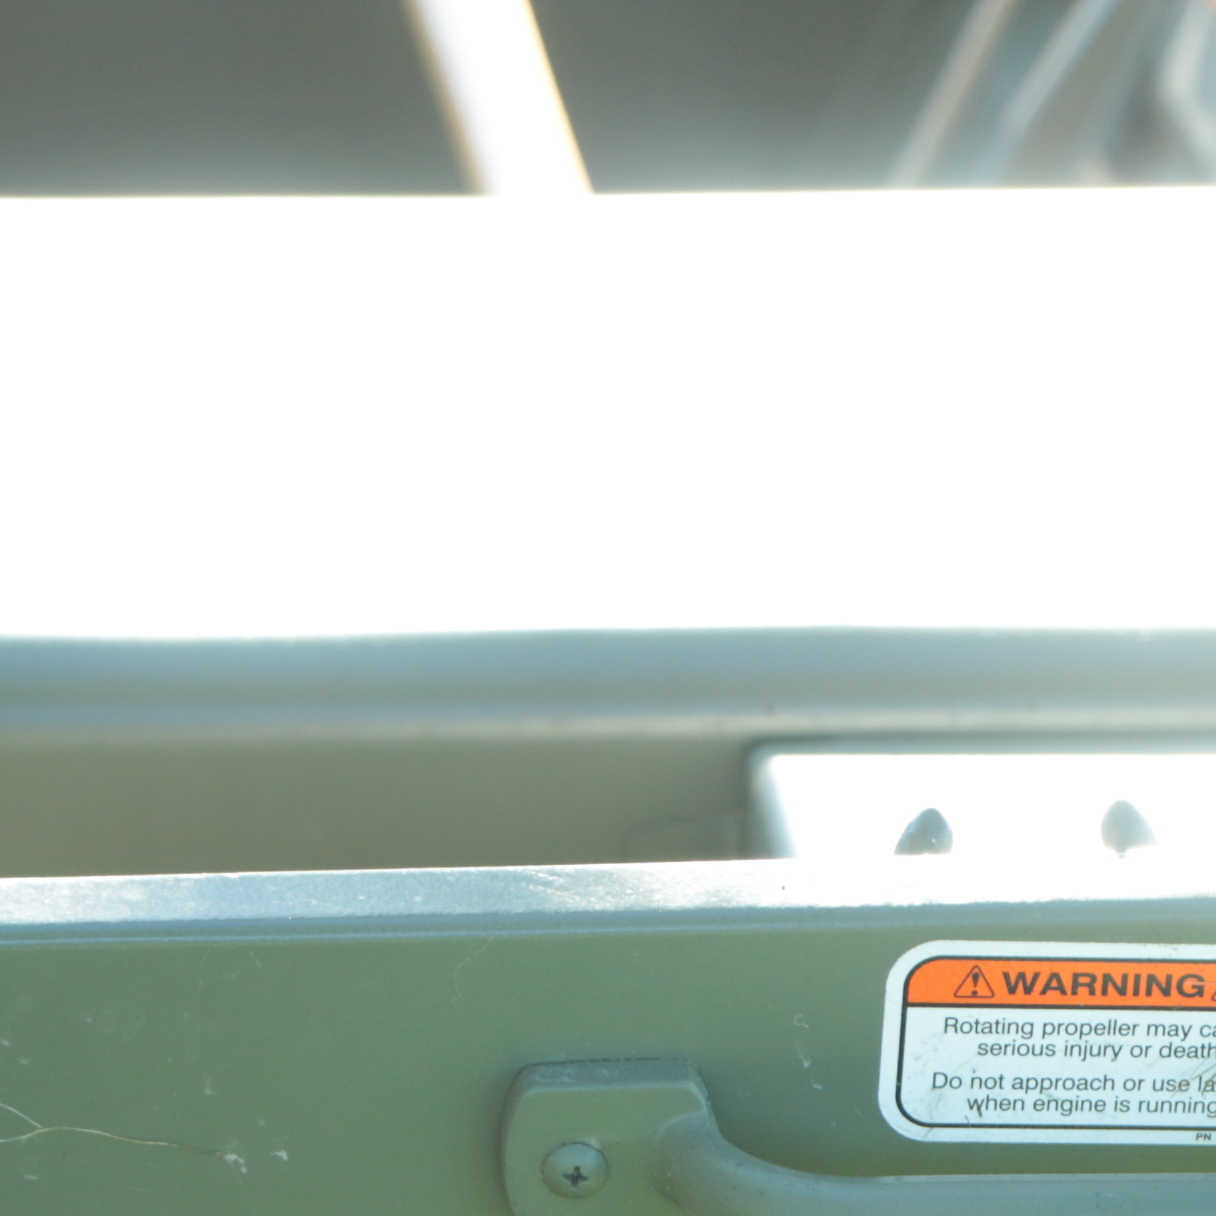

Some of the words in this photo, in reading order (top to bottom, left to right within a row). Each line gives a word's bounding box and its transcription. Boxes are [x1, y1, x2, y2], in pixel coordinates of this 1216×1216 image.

[1002, 971, 1205, 999] WARNING
[943, 1017, 1035, 1039] Rotating
[1042, 1018, 1139, 1040] propeller
[1146, 1023, 1192, 1041] may
[978, 1041, 1056, 1057] serious
[1064, 1041, 1123, 1062] injury
[1130, 1044, 1152, 1058] or
[932, 1072, 962, 1090] Do
[970, 1074, 1004, 1090] not
[1011, 1074, 1116, 1095] approach
[1122, 1077, 1145, 1091] or
[1152, 1077, 1190, 1092] use
[968, 1094, 1025, 1112] when
[1033, 1096, 1105, 1116] engine
[1114, 1096, 1130, 1113] is
[1196, 1132, 1211, 1141] PN
